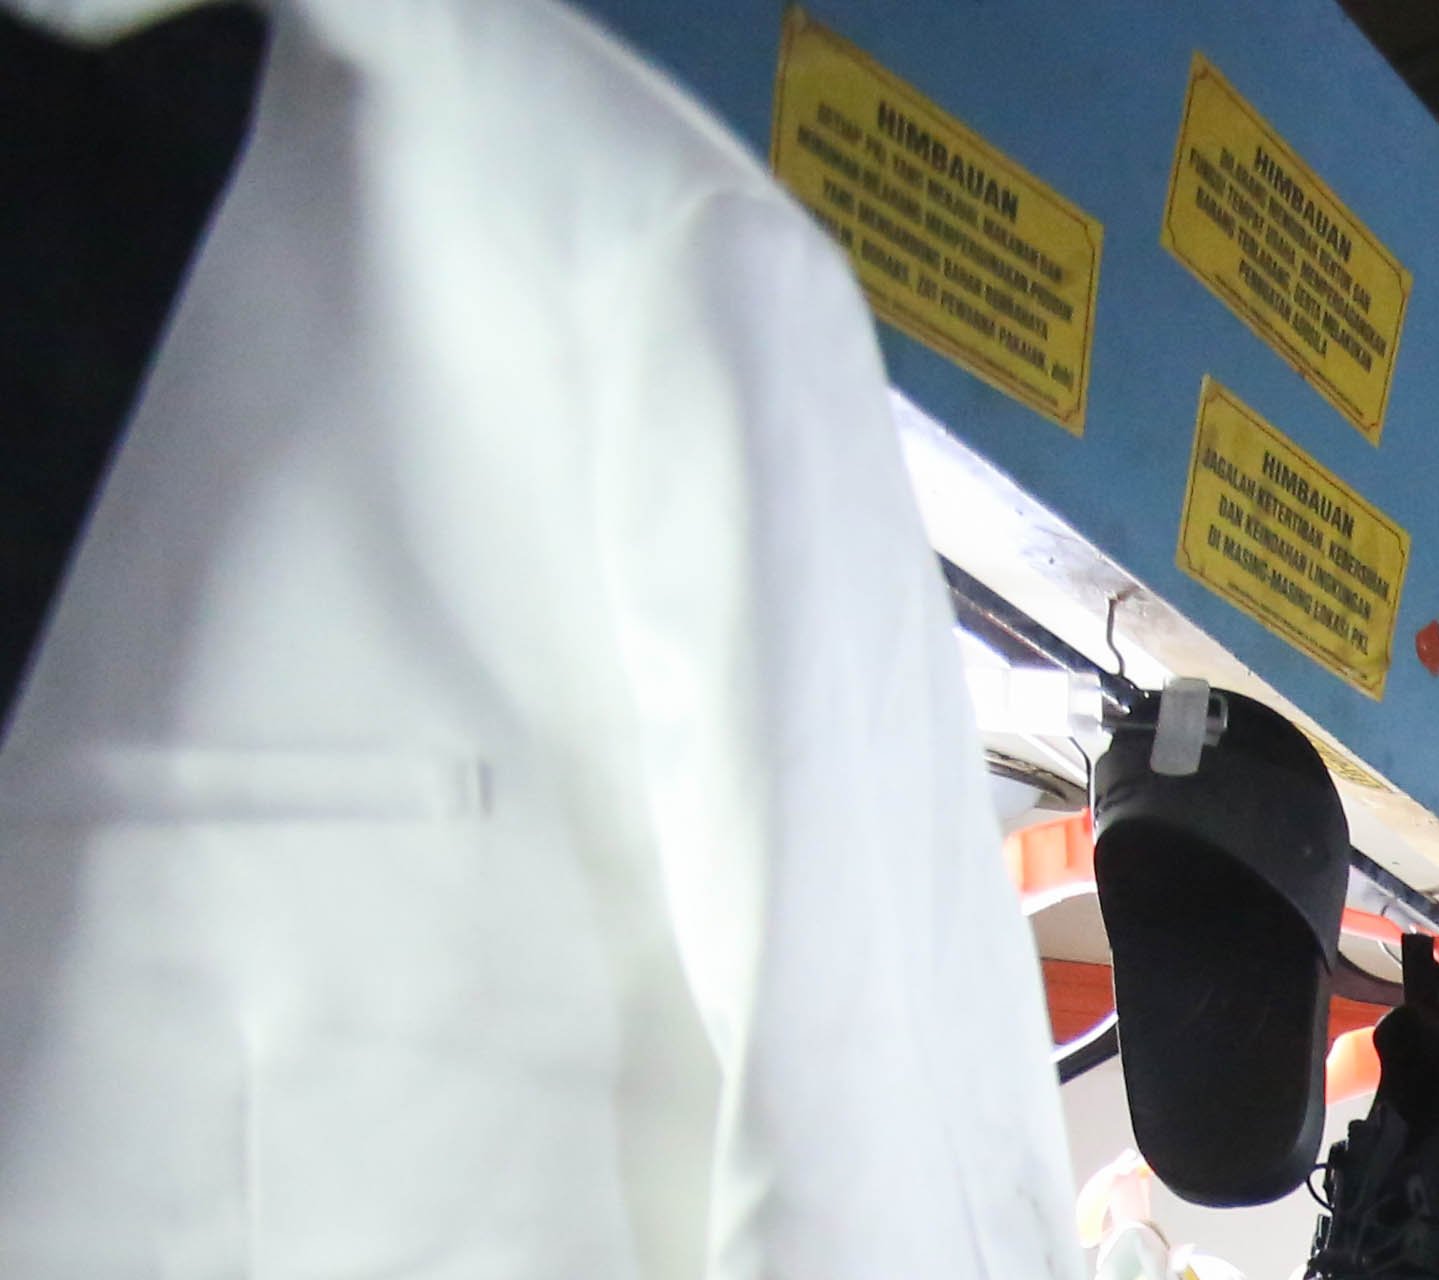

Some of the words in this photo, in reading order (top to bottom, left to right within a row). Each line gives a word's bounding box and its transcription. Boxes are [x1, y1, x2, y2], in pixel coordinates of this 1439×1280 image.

[876, 98, 1018, 224] HIMBAUAN
[1253, 144, 1352, 263] HIMBAUAN
[1202, 444, 1256, 502] JAGALAH
[1262, 449, 1354, 539] HIMBAUAN
[1207, 523, 1220, 551] DI
[1218, 493, 1243, 530] DAN
